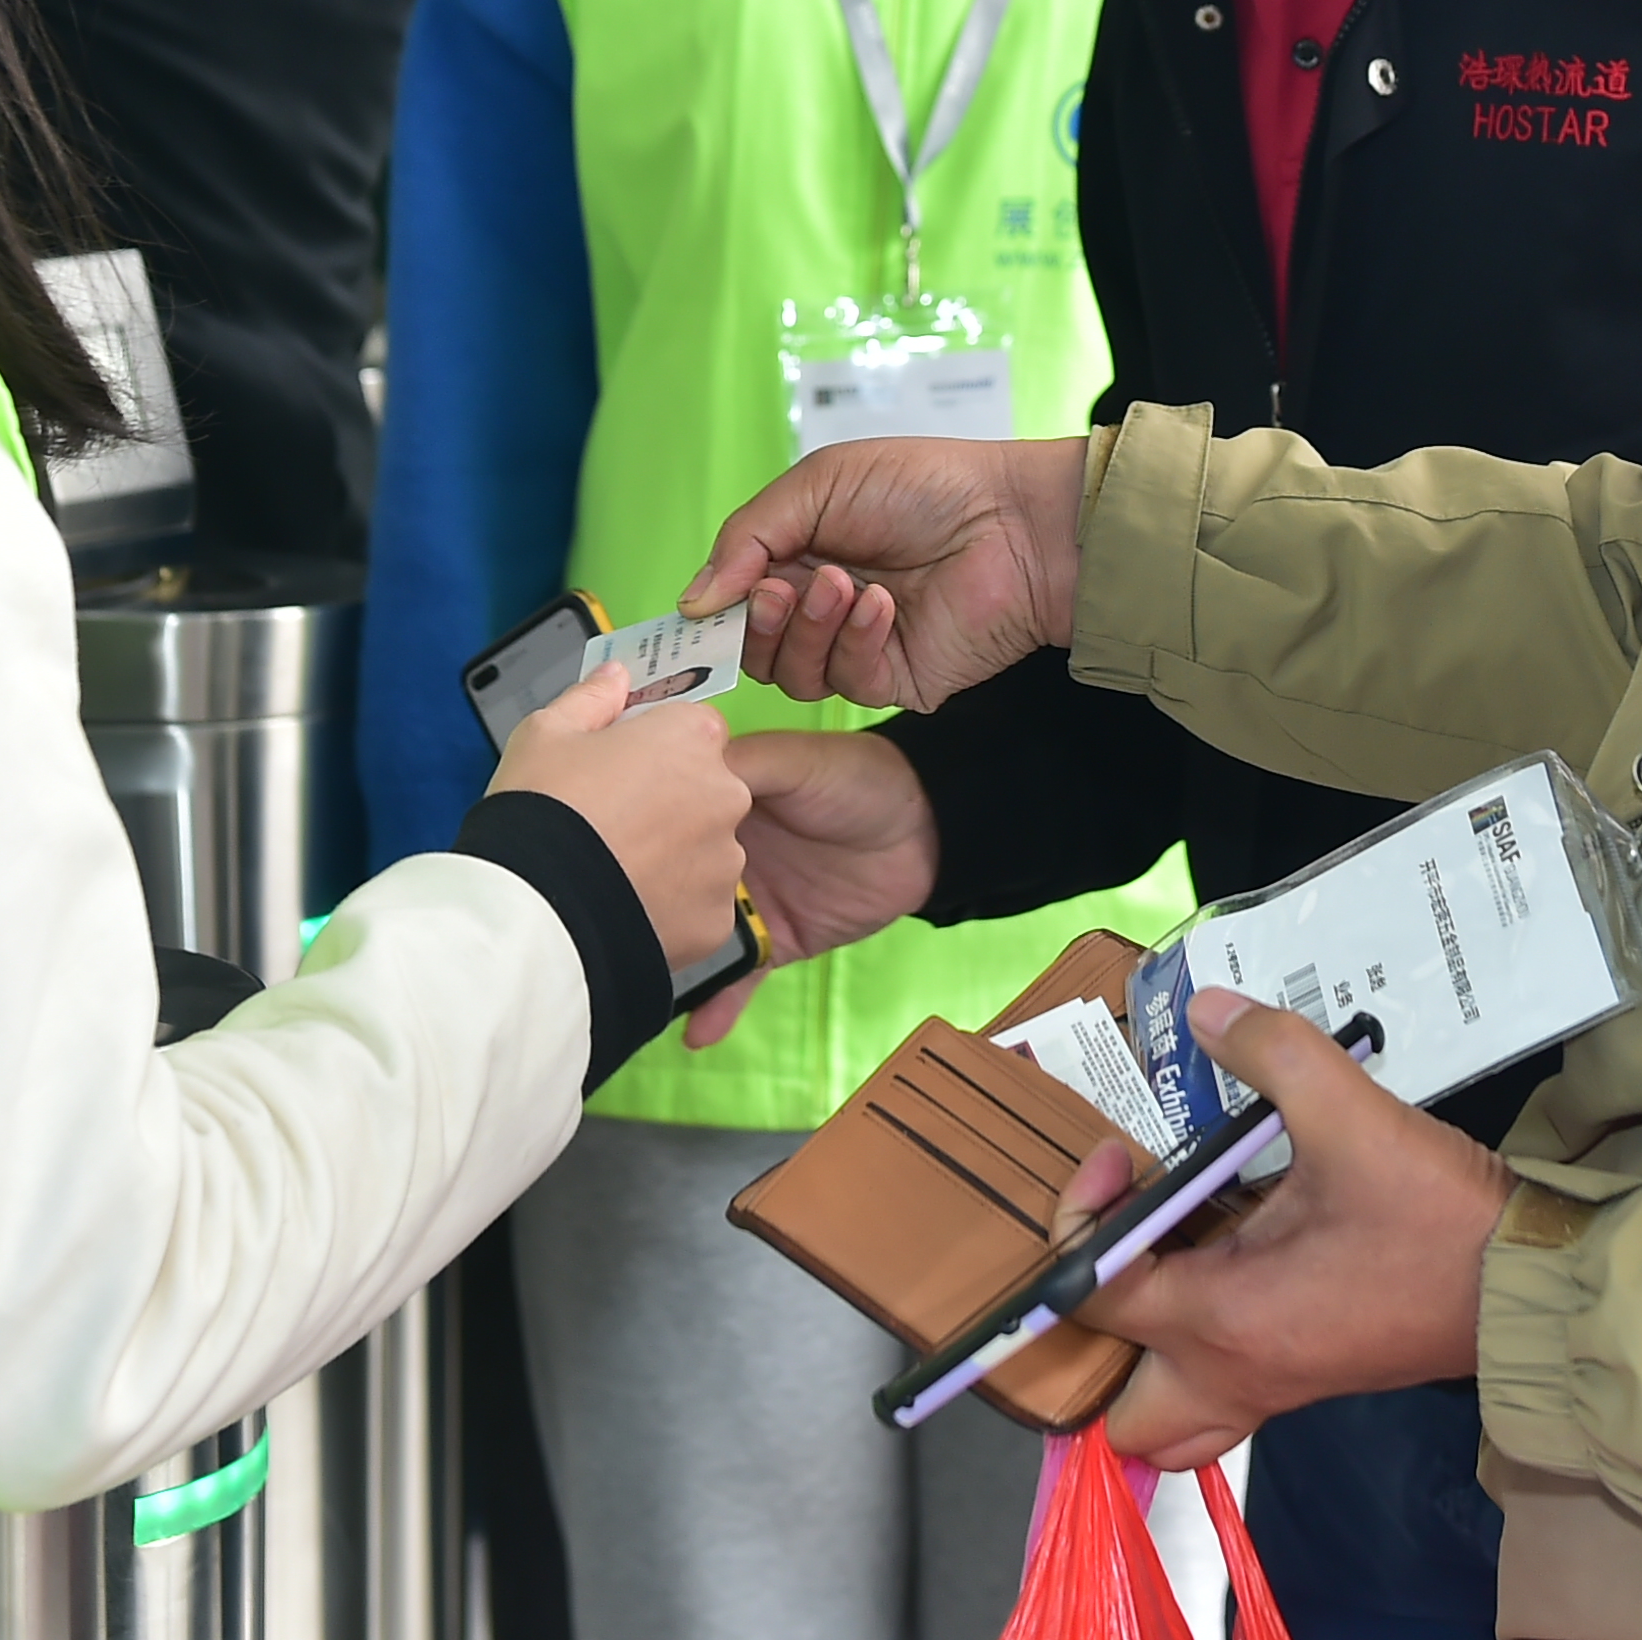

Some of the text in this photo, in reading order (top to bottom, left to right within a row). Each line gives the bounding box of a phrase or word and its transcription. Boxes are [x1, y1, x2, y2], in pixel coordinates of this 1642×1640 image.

[1472, 103, 1610, 147] HOSTAR
[1492, 820, 1522, 863] SIAF
[1145, 991, 1179, 1061] 参展商
